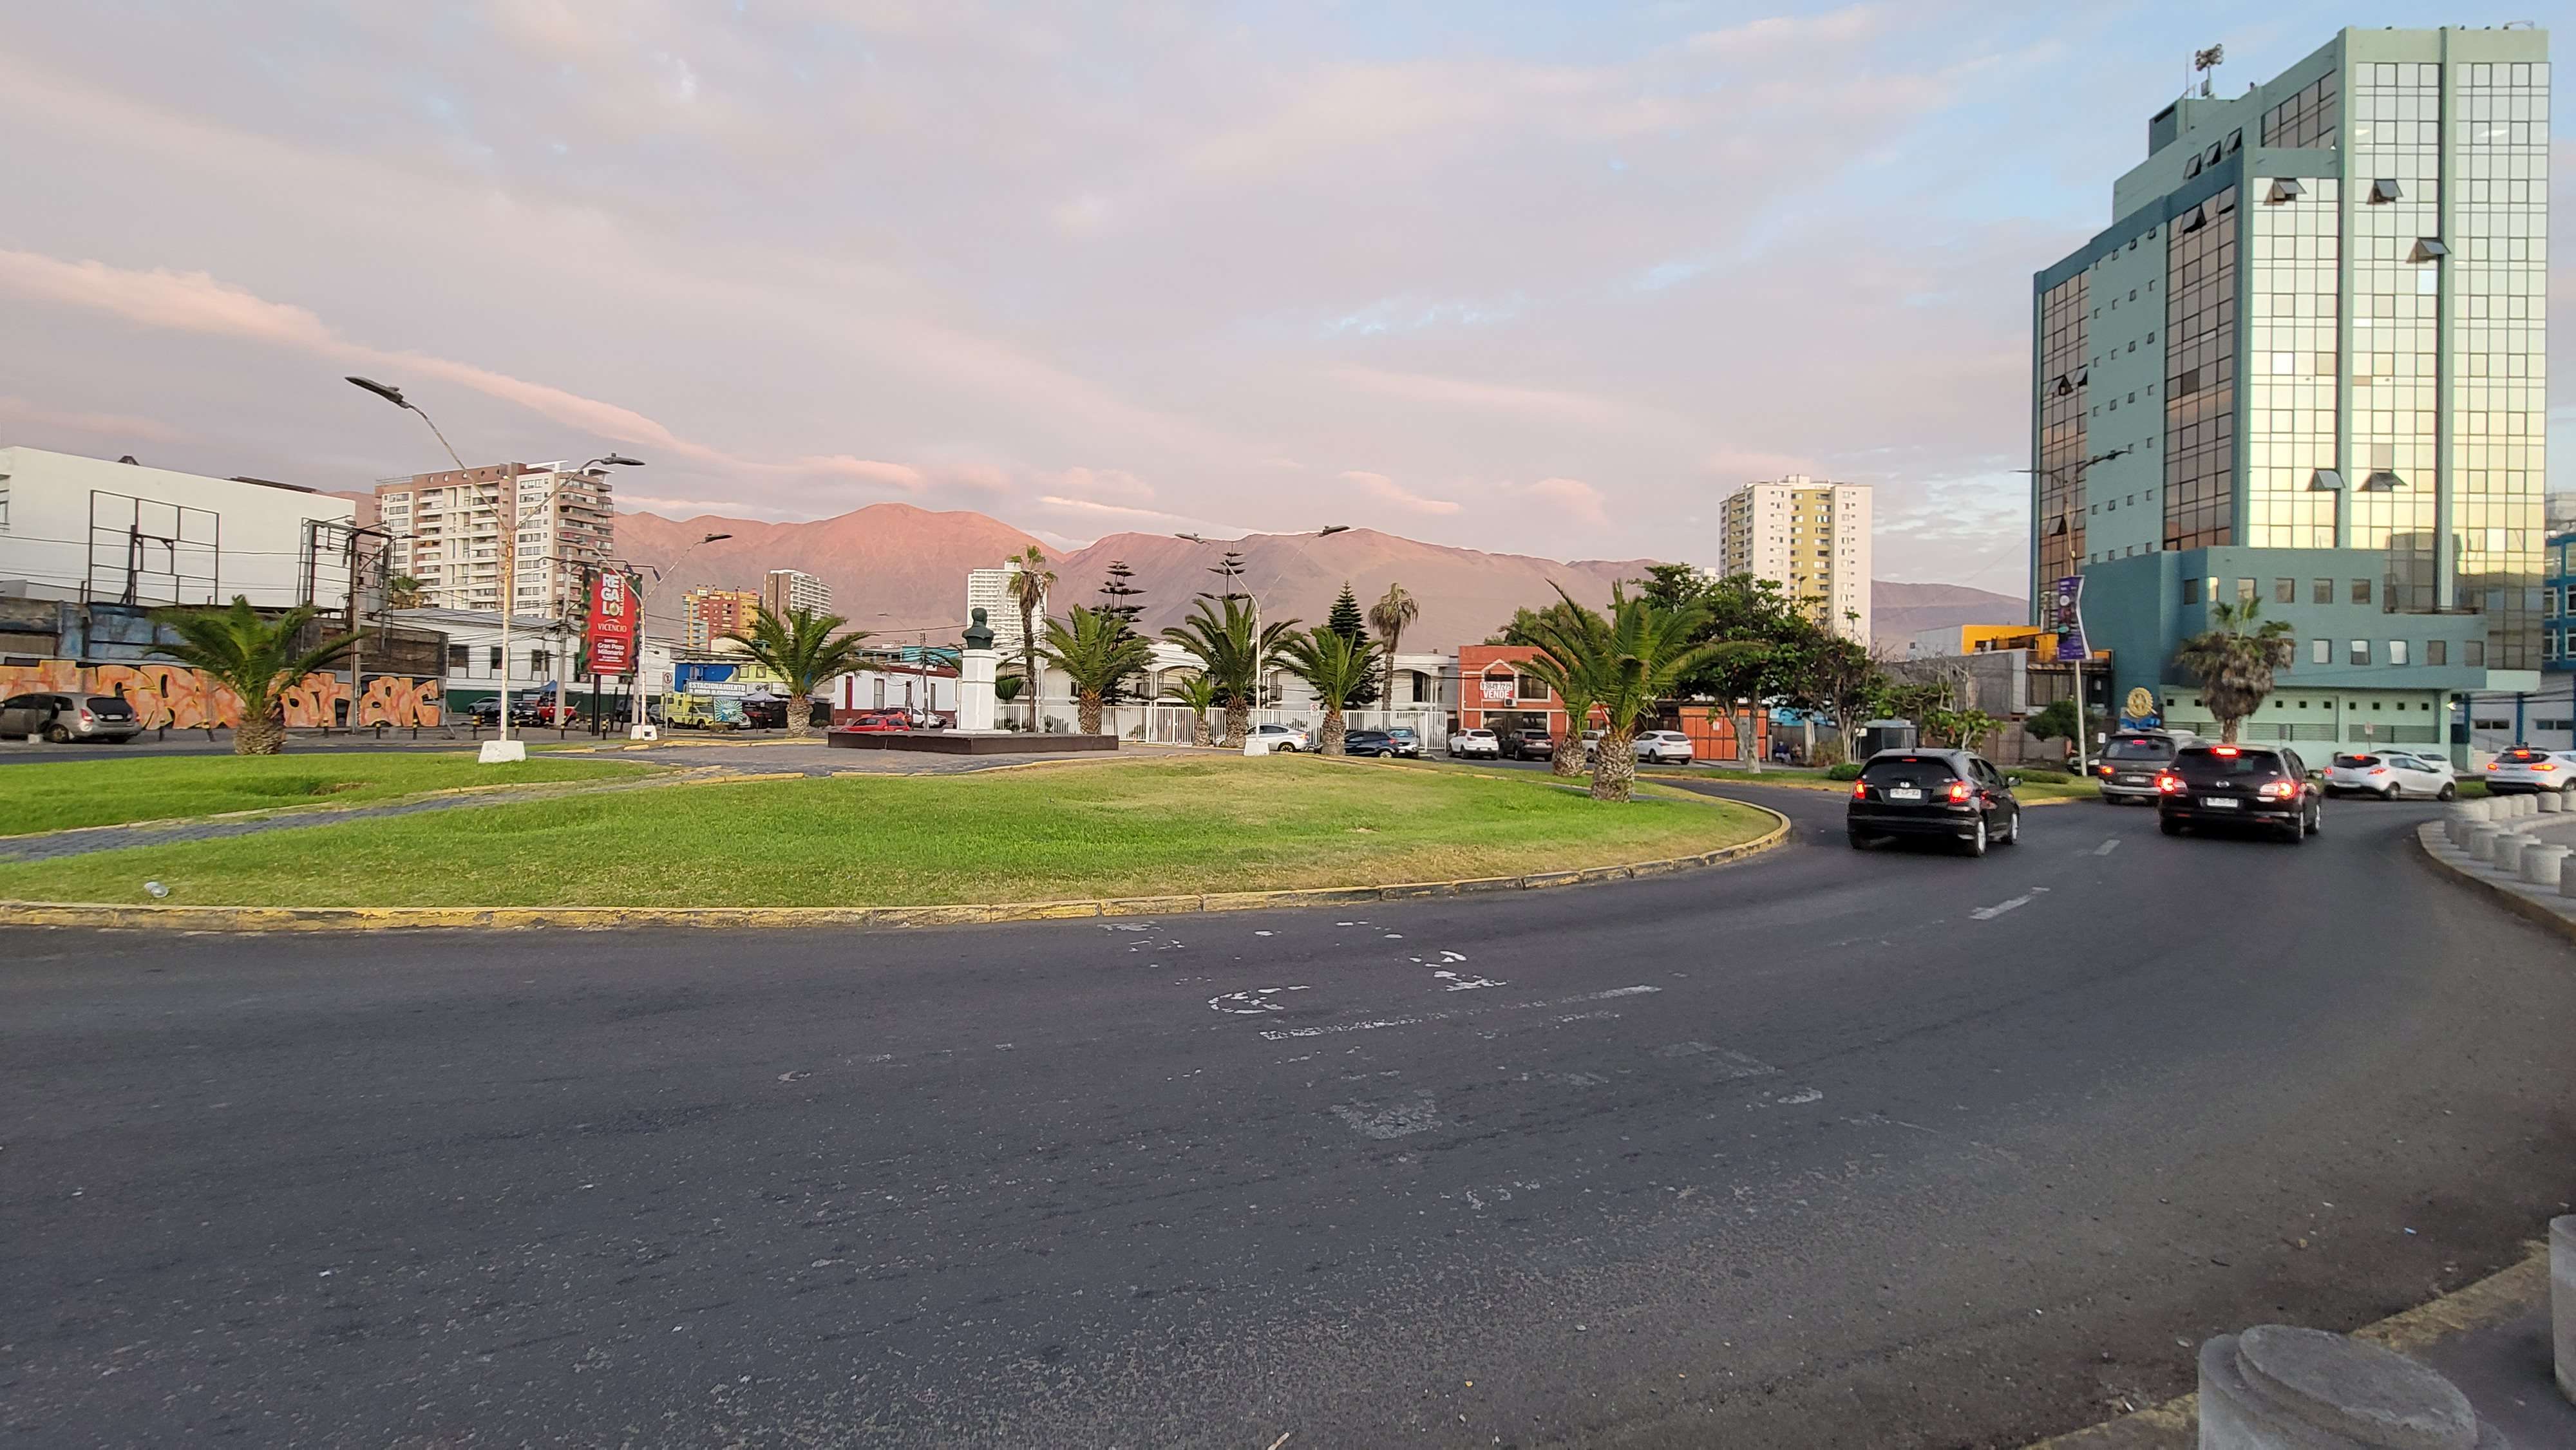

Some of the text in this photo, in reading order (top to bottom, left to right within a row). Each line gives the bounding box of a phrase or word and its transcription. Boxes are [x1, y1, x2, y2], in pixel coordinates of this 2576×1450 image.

[602, 573, 620, 588] RE
[601, 587, 620, 602] GA
[598, 623, 627, 632] VICENCIO
[688, 682, 746, 692] ESTACIONAMIENTO
[1483, 690, 1510, 699] VENDE
